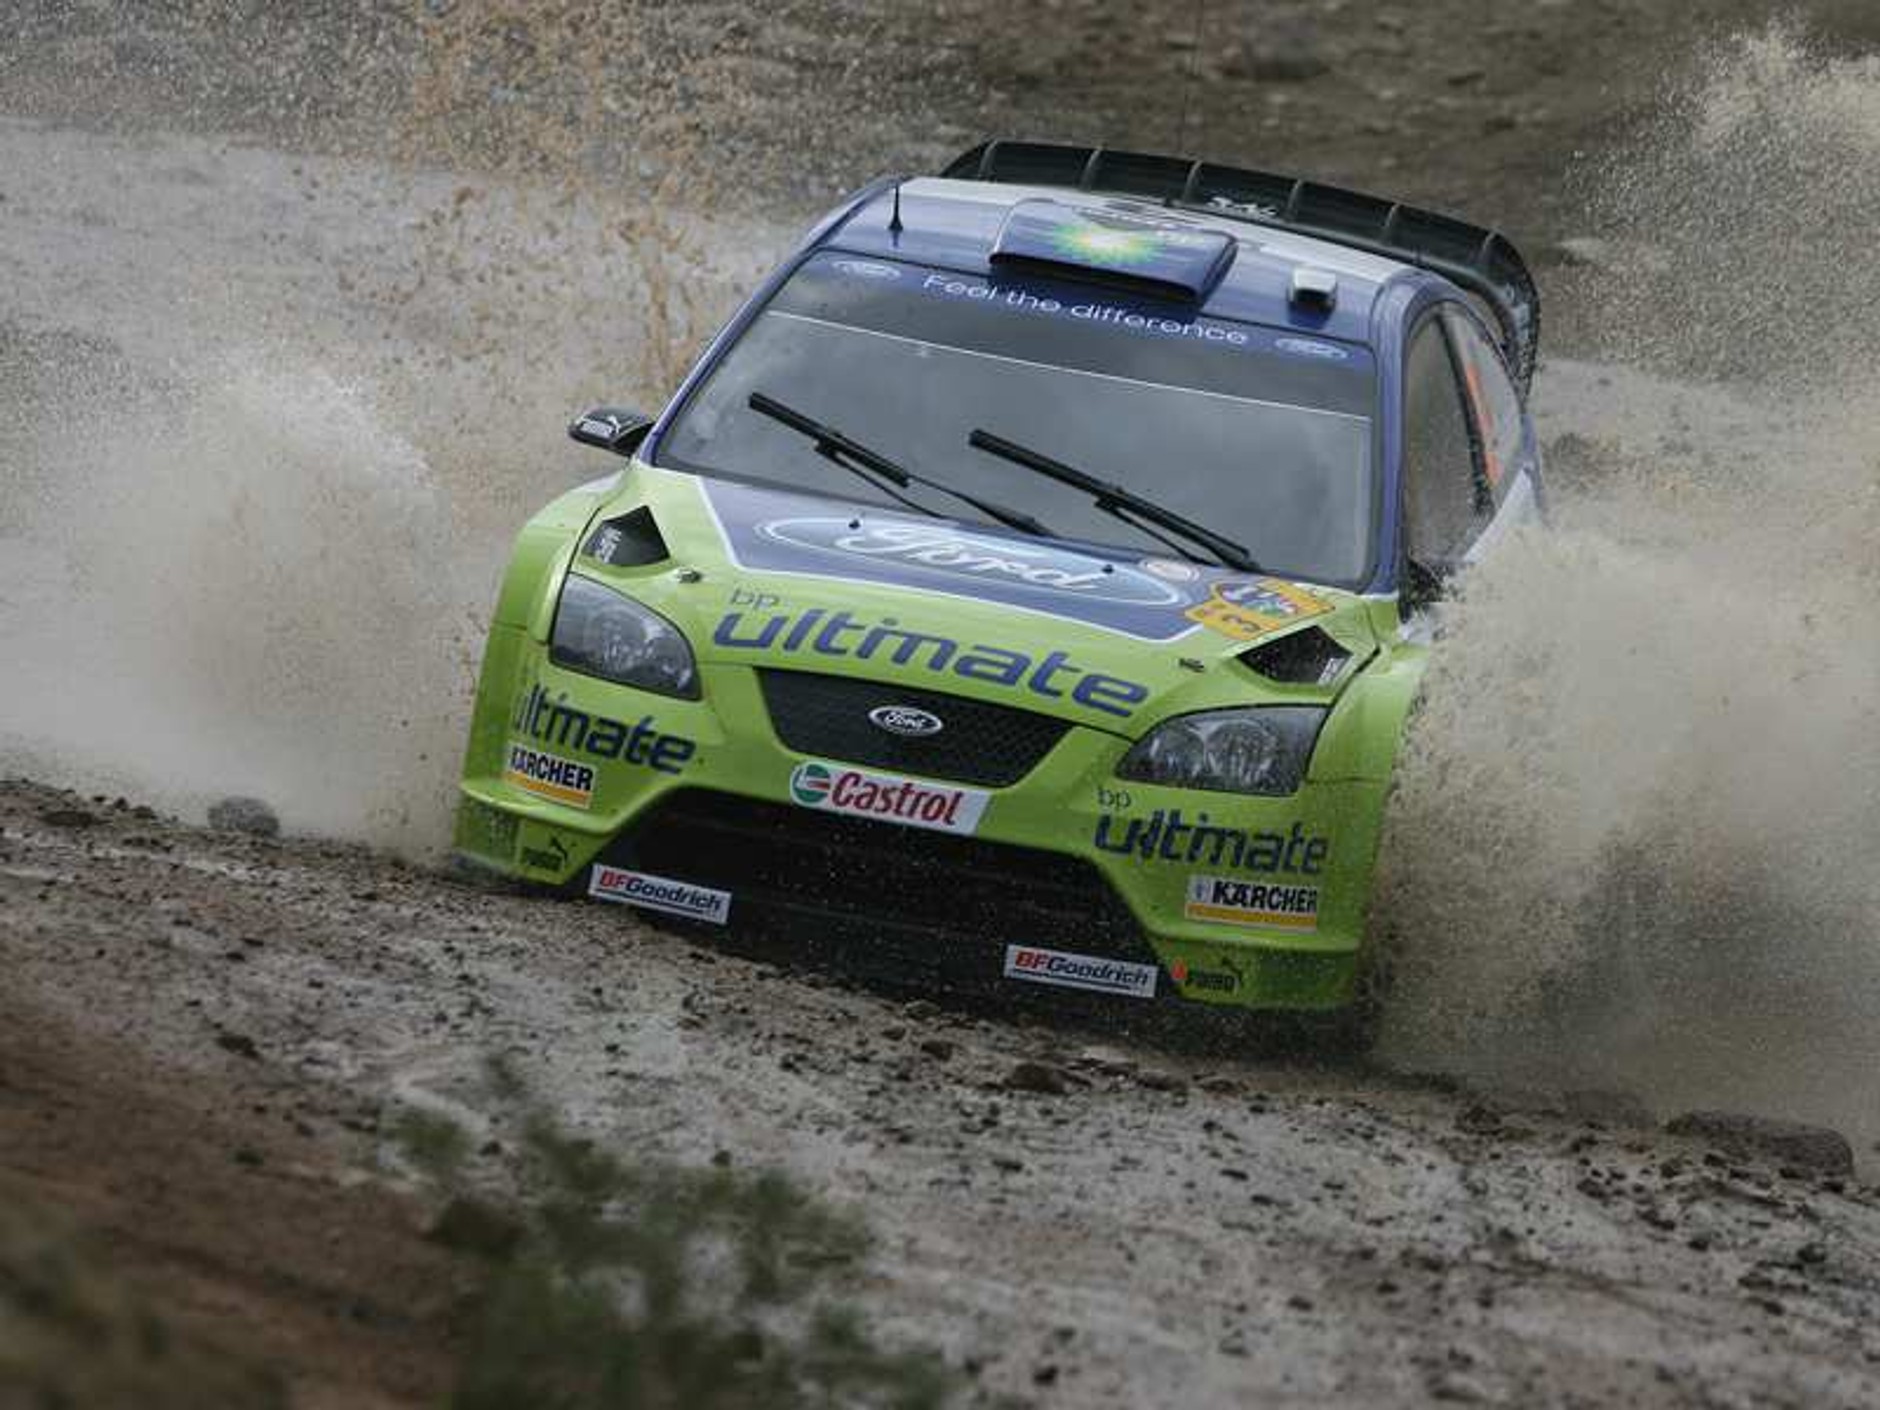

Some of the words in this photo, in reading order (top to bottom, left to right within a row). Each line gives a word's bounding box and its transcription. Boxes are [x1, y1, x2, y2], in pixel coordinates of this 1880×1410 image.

[923, 274, 998, 300] Feel
[1006, 289, 1061, 312] the
[1071, 302, 1247, 345] difference
[834, 526, 1109, 589] Ford
[730, 588, 781, 610] bp
[713, 607, 1150, 718] ultimate
[831, 772, 964, 826] Castrol
[1097, 787, 1131, 809] bp
[1095, 810, 1328, 875] ultimate
[601, 869, 721, 911] BFGoodrich
[1015, 951, 1148, 987] BFGoodrich
